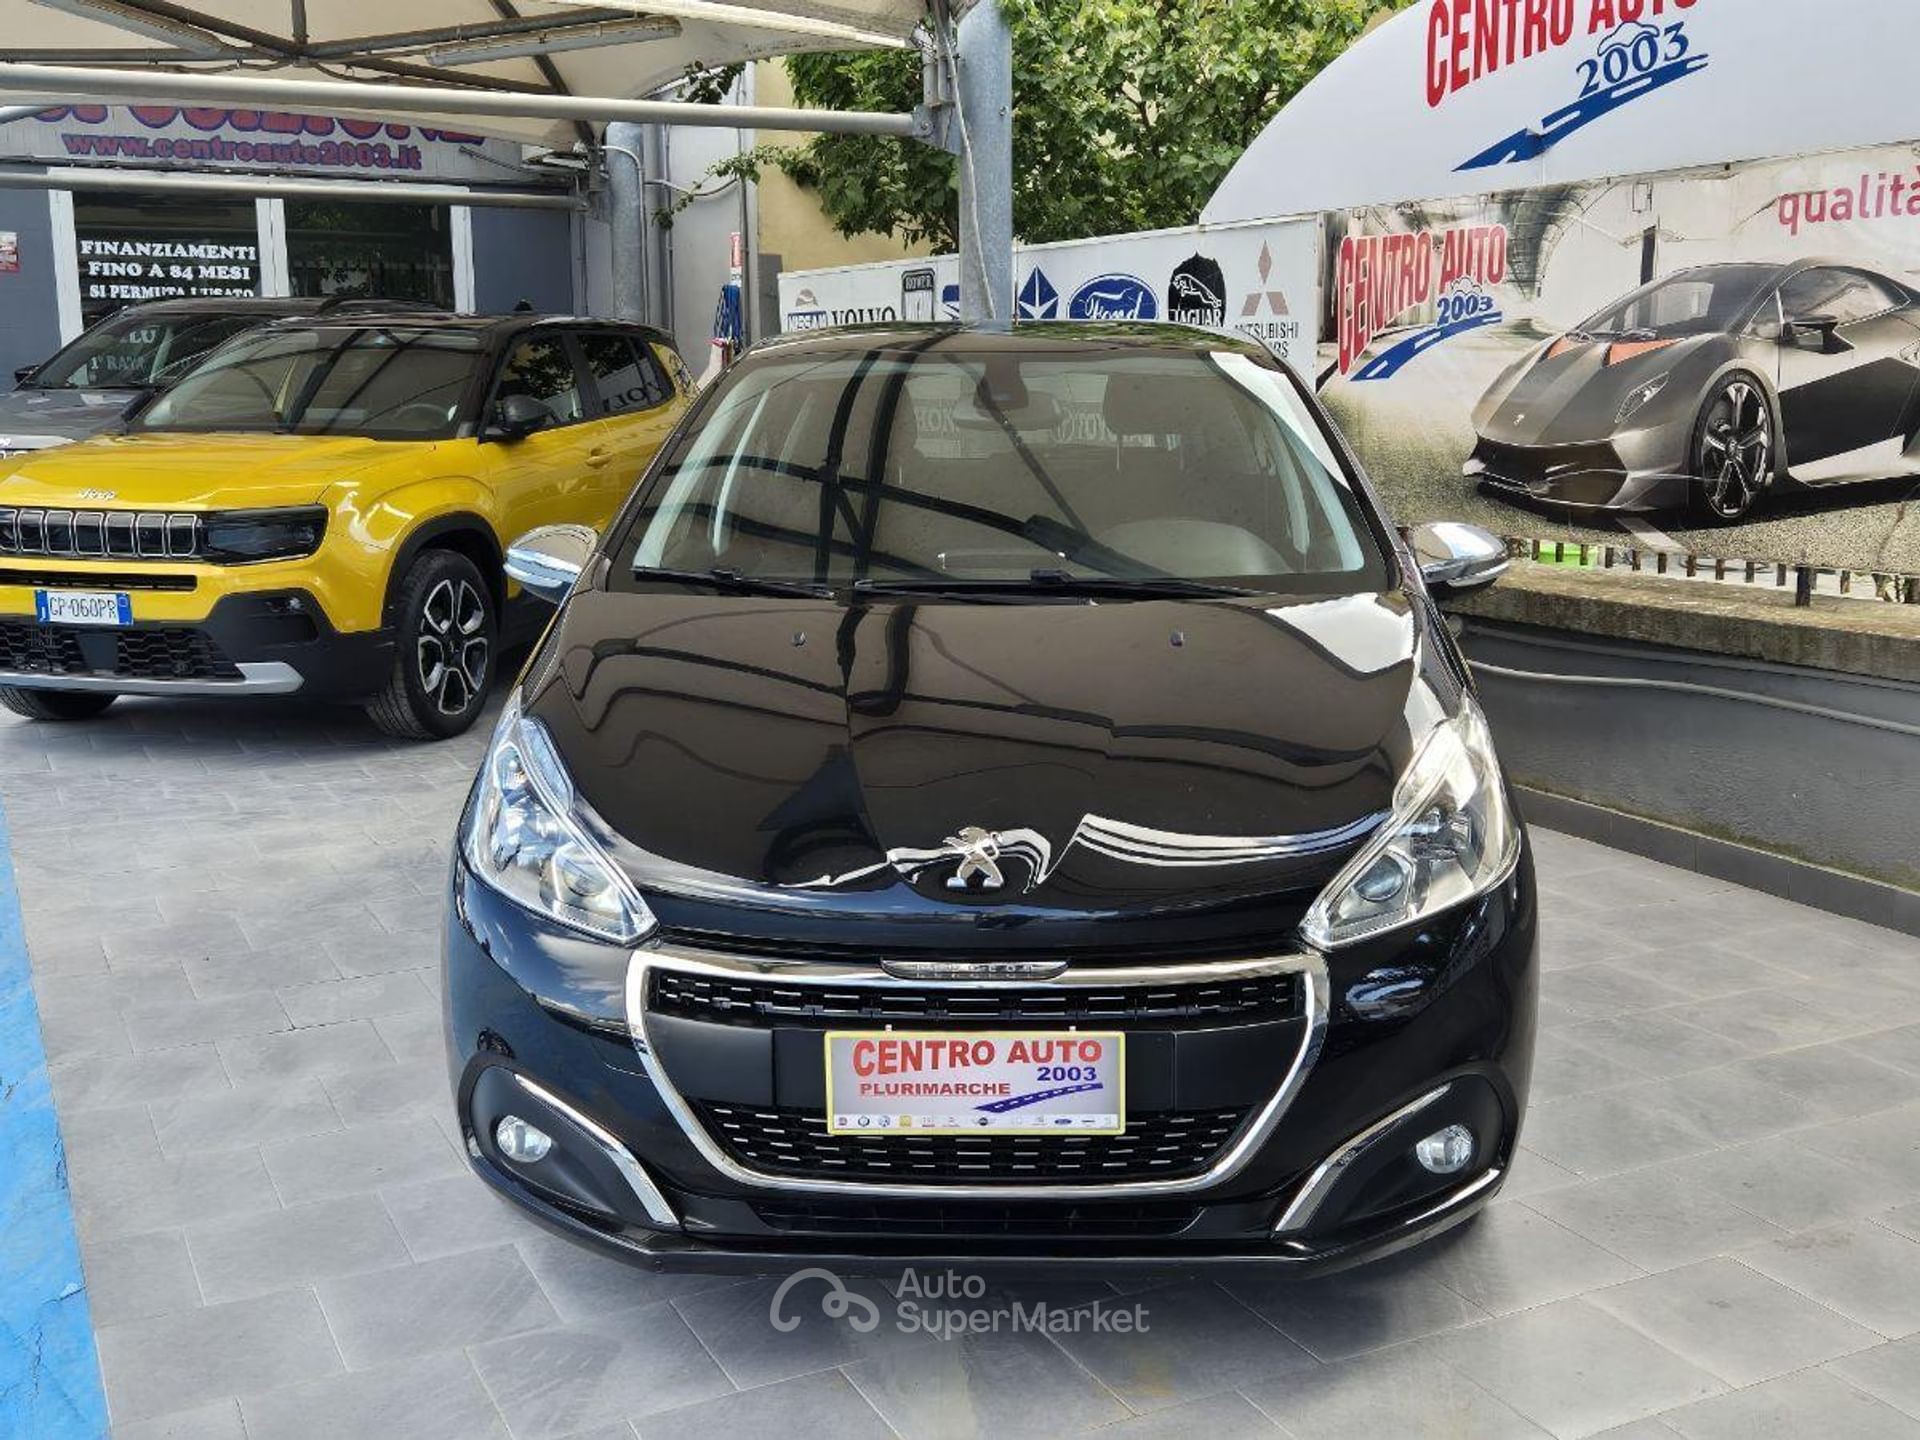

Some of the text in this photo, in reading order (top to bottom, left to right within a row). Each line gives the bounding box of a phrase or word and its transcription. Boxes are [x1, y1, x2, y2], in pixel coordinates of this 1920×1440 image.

[1427, 0, 1575, 108] CENTRO
[1576, 21, 1689, 99] 2003
[61, 132, 422, 171] www.centroauto2003.it
[80, 240, 256, 261] FINANZIAMENTI
[88, 261, 250, 281] FINO A 84 MESI
[89, 284, 106, 298] SI
[1338, 226, 1506, 375] CENTRO AUTO
[831, 306, 896, 327] VOLVO
[1169, 307, 1223, 327] JAGUAR
[1437, 296, 1493, 326] 2003
[1235, 322, 1299, 340] TSUBISHI
[853, 1040, 1102, 1076] CENTRO AUTO
[1037, 1067, 1097, 1082] 2003
[860, 1082, 1011, 1097] PLURIMARCHE
